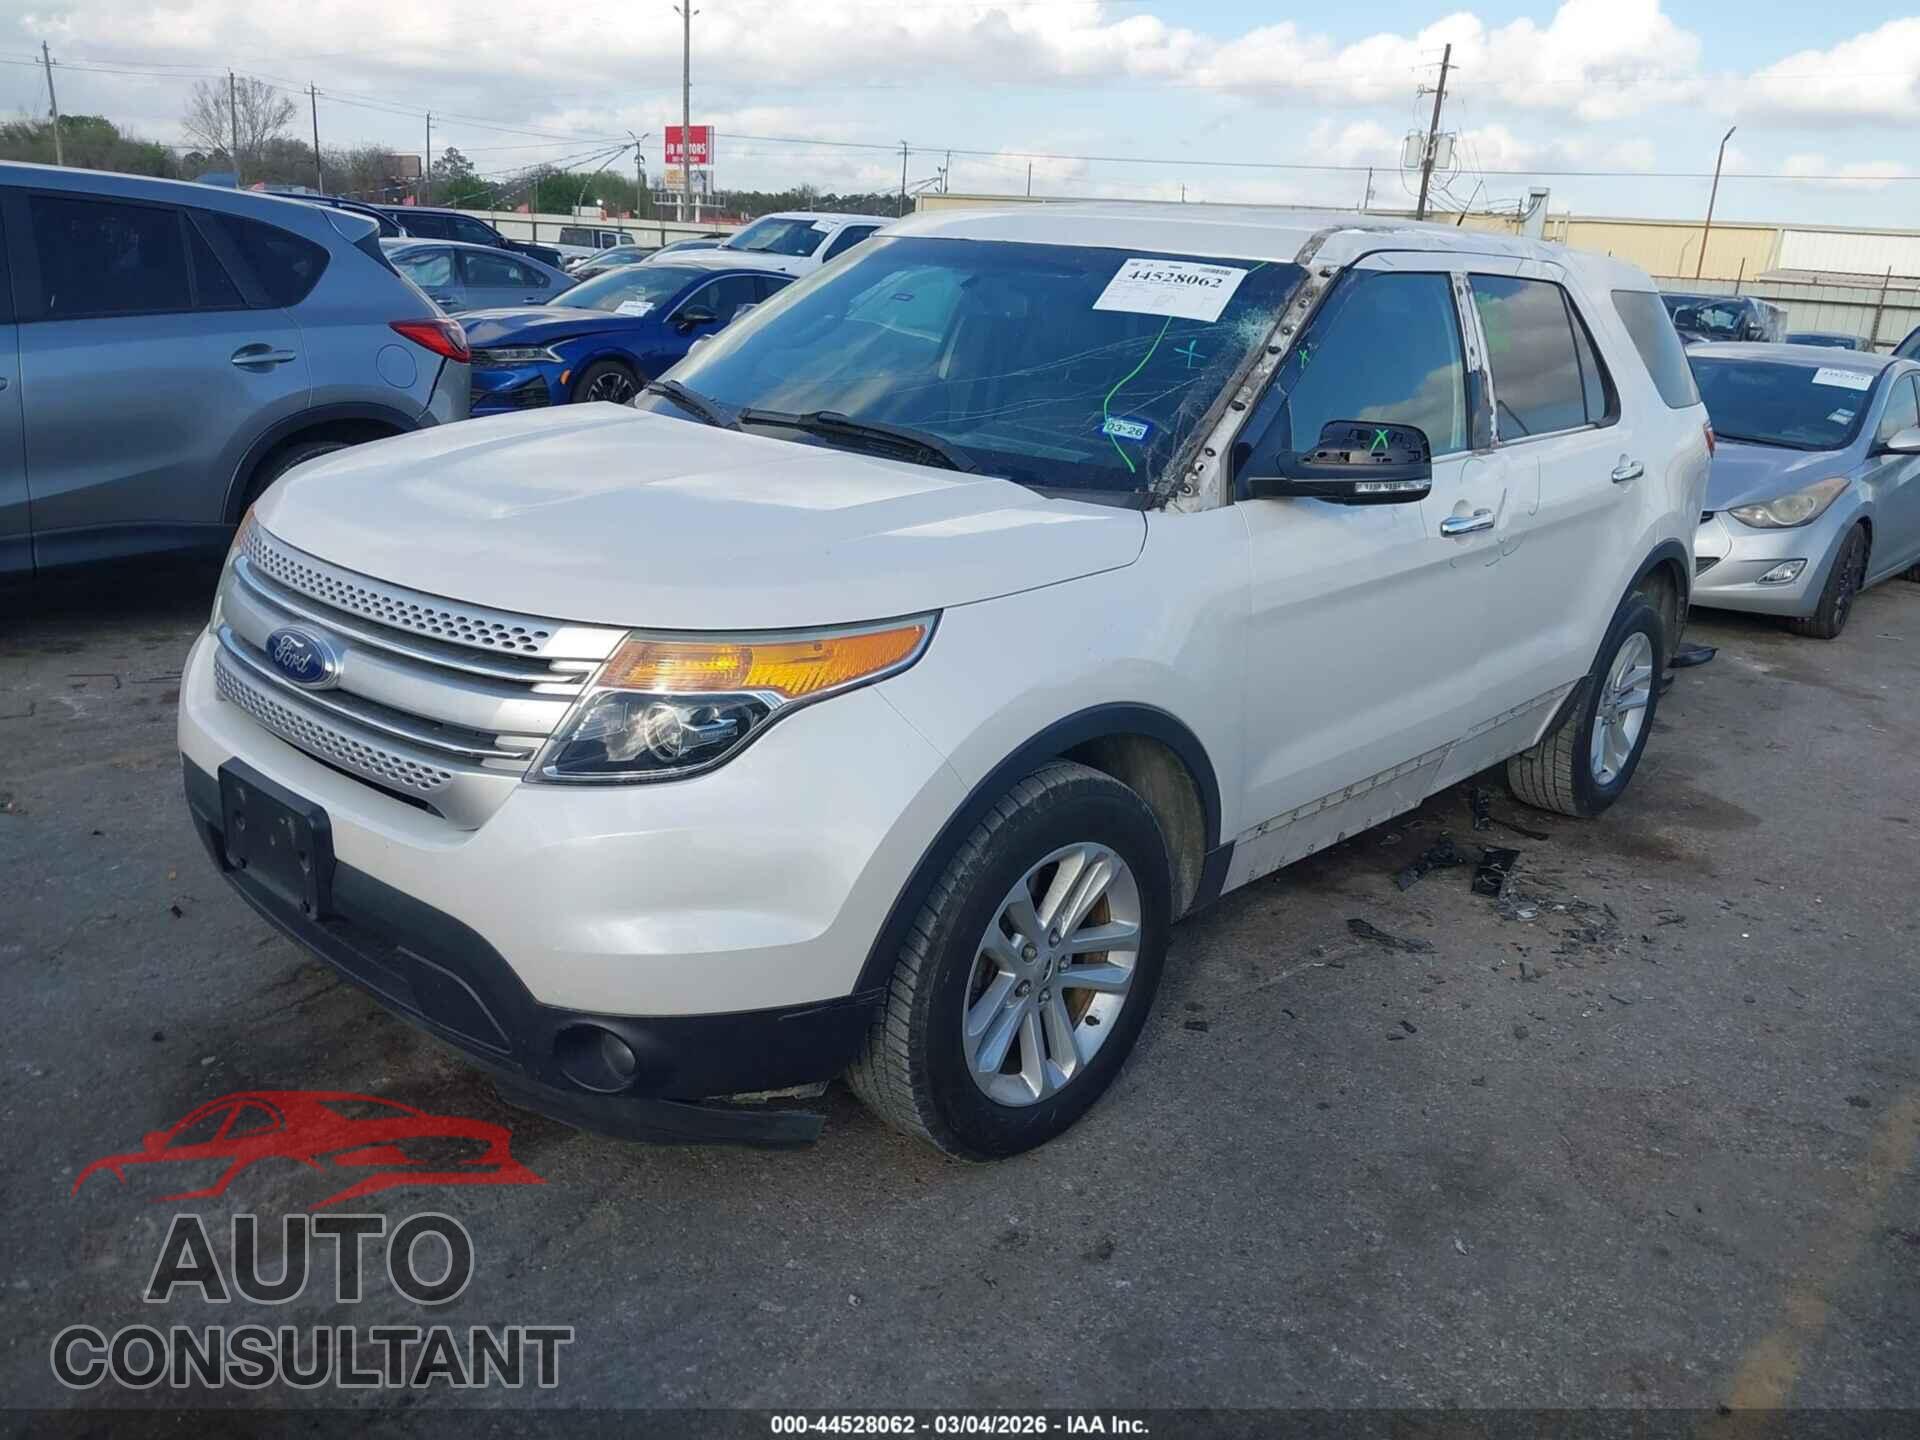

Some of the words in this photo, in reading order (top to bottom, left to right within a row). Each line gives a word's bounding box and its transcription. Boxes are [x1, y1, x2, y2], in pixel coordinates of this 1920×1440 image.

[676, 143, 706, 154] MTORS
[1128, 270, 1223, 288] 44528062
[274, 634, 312, 673] Ford
